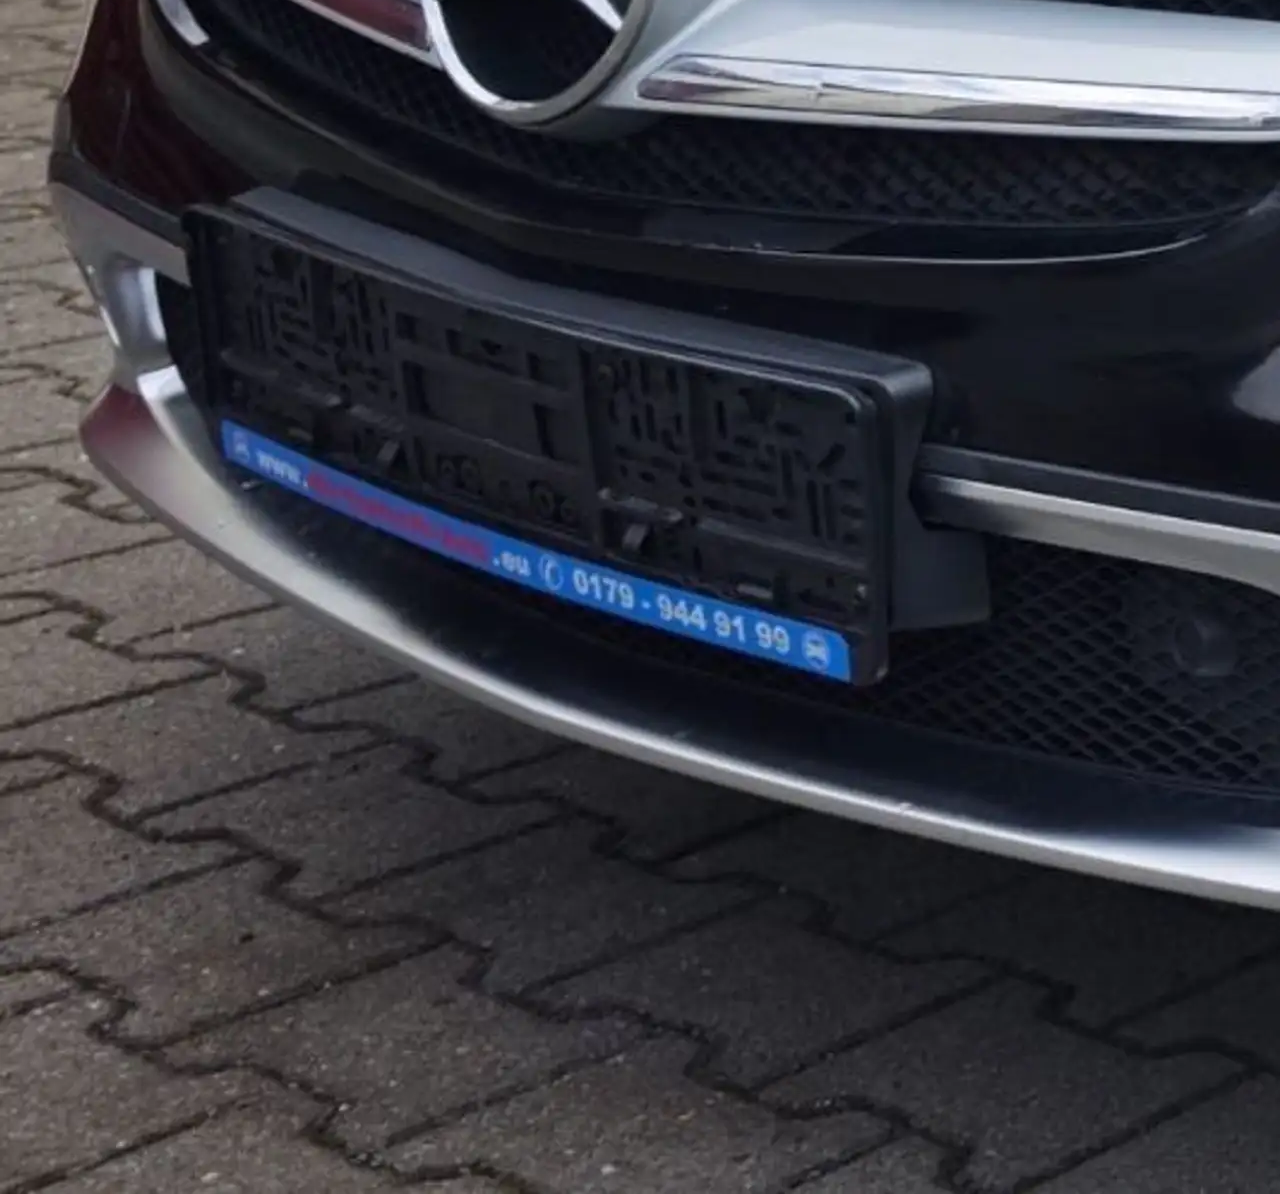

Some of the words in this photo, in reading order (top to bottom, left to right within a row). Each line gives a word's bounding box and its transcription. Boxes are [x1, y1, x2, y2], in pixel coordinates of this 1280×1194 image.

[572, 569, 634, 609] 0179
[656, 594, 708, 631] 944
[714, 610, 747, 643] 91
[756, 623, 791, 654] 99
